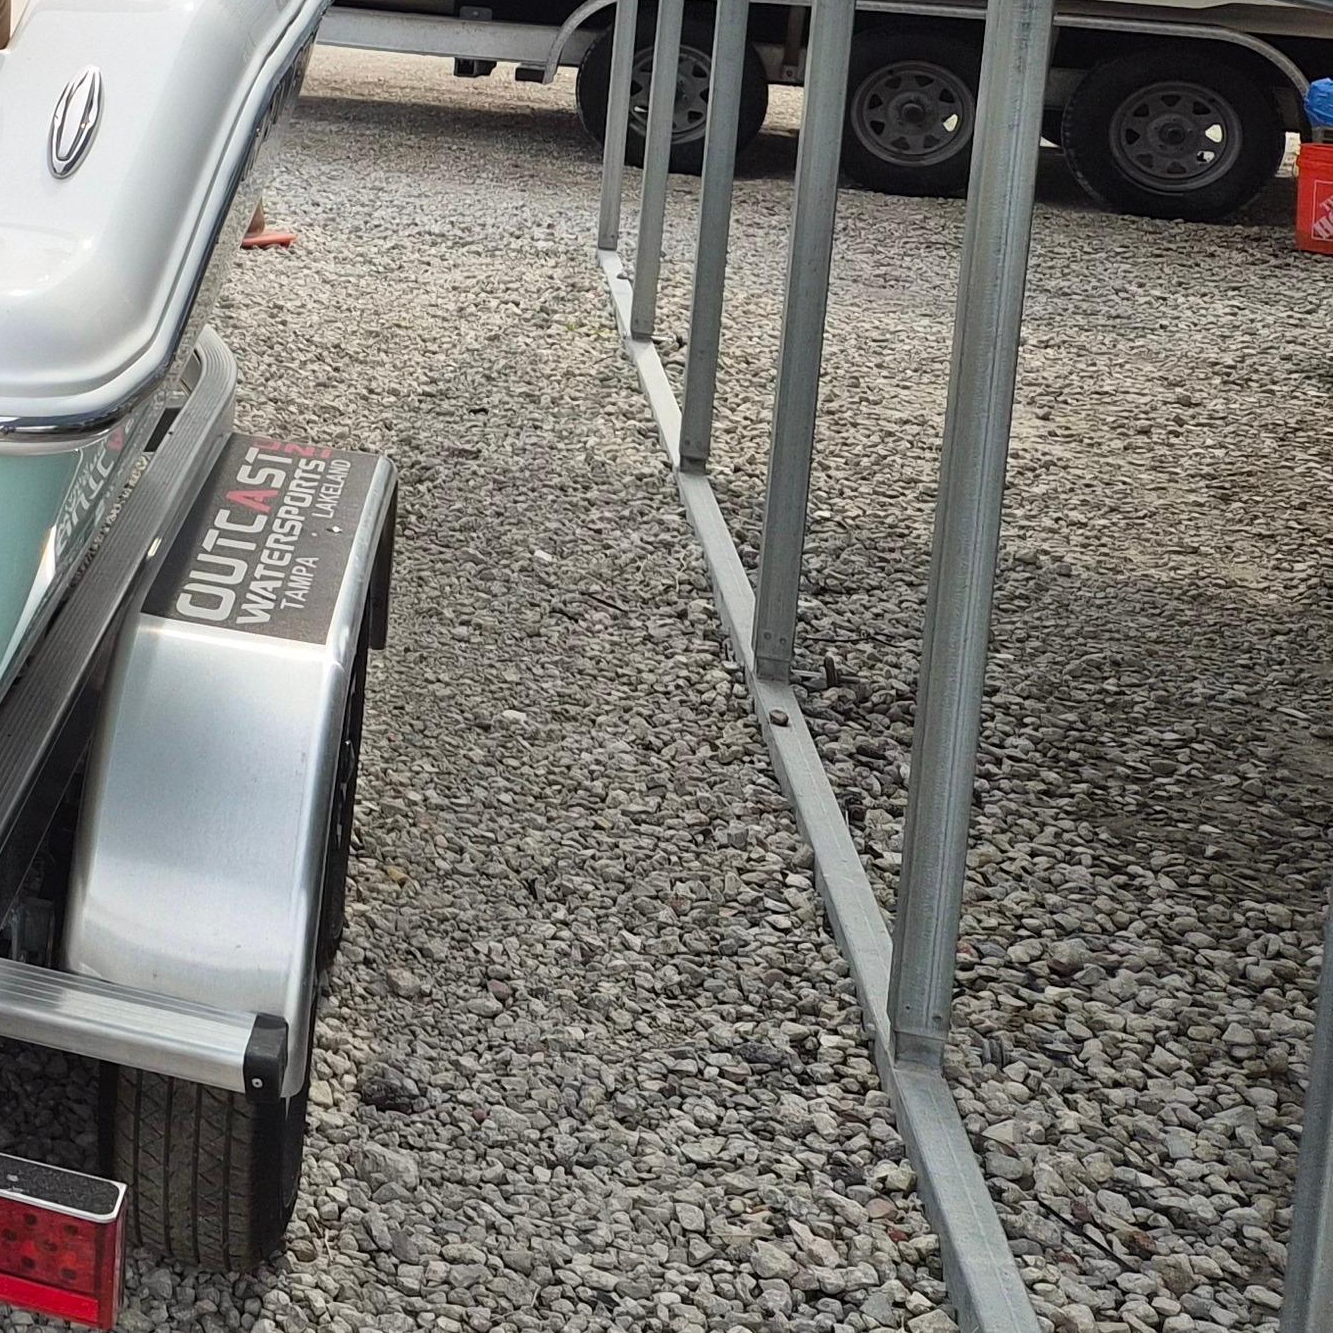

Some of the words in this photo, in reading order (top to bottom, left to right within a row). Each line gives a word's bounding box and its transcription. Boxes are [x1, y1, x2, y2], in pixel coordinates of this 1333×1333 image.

[175, 446, 294, 622] OUTCAST
[235, 457, 326, 625] WATERSPORTS
[279, 556, 320, 609] TAMPA
[311, 458, 352, 519] LAKELAND
